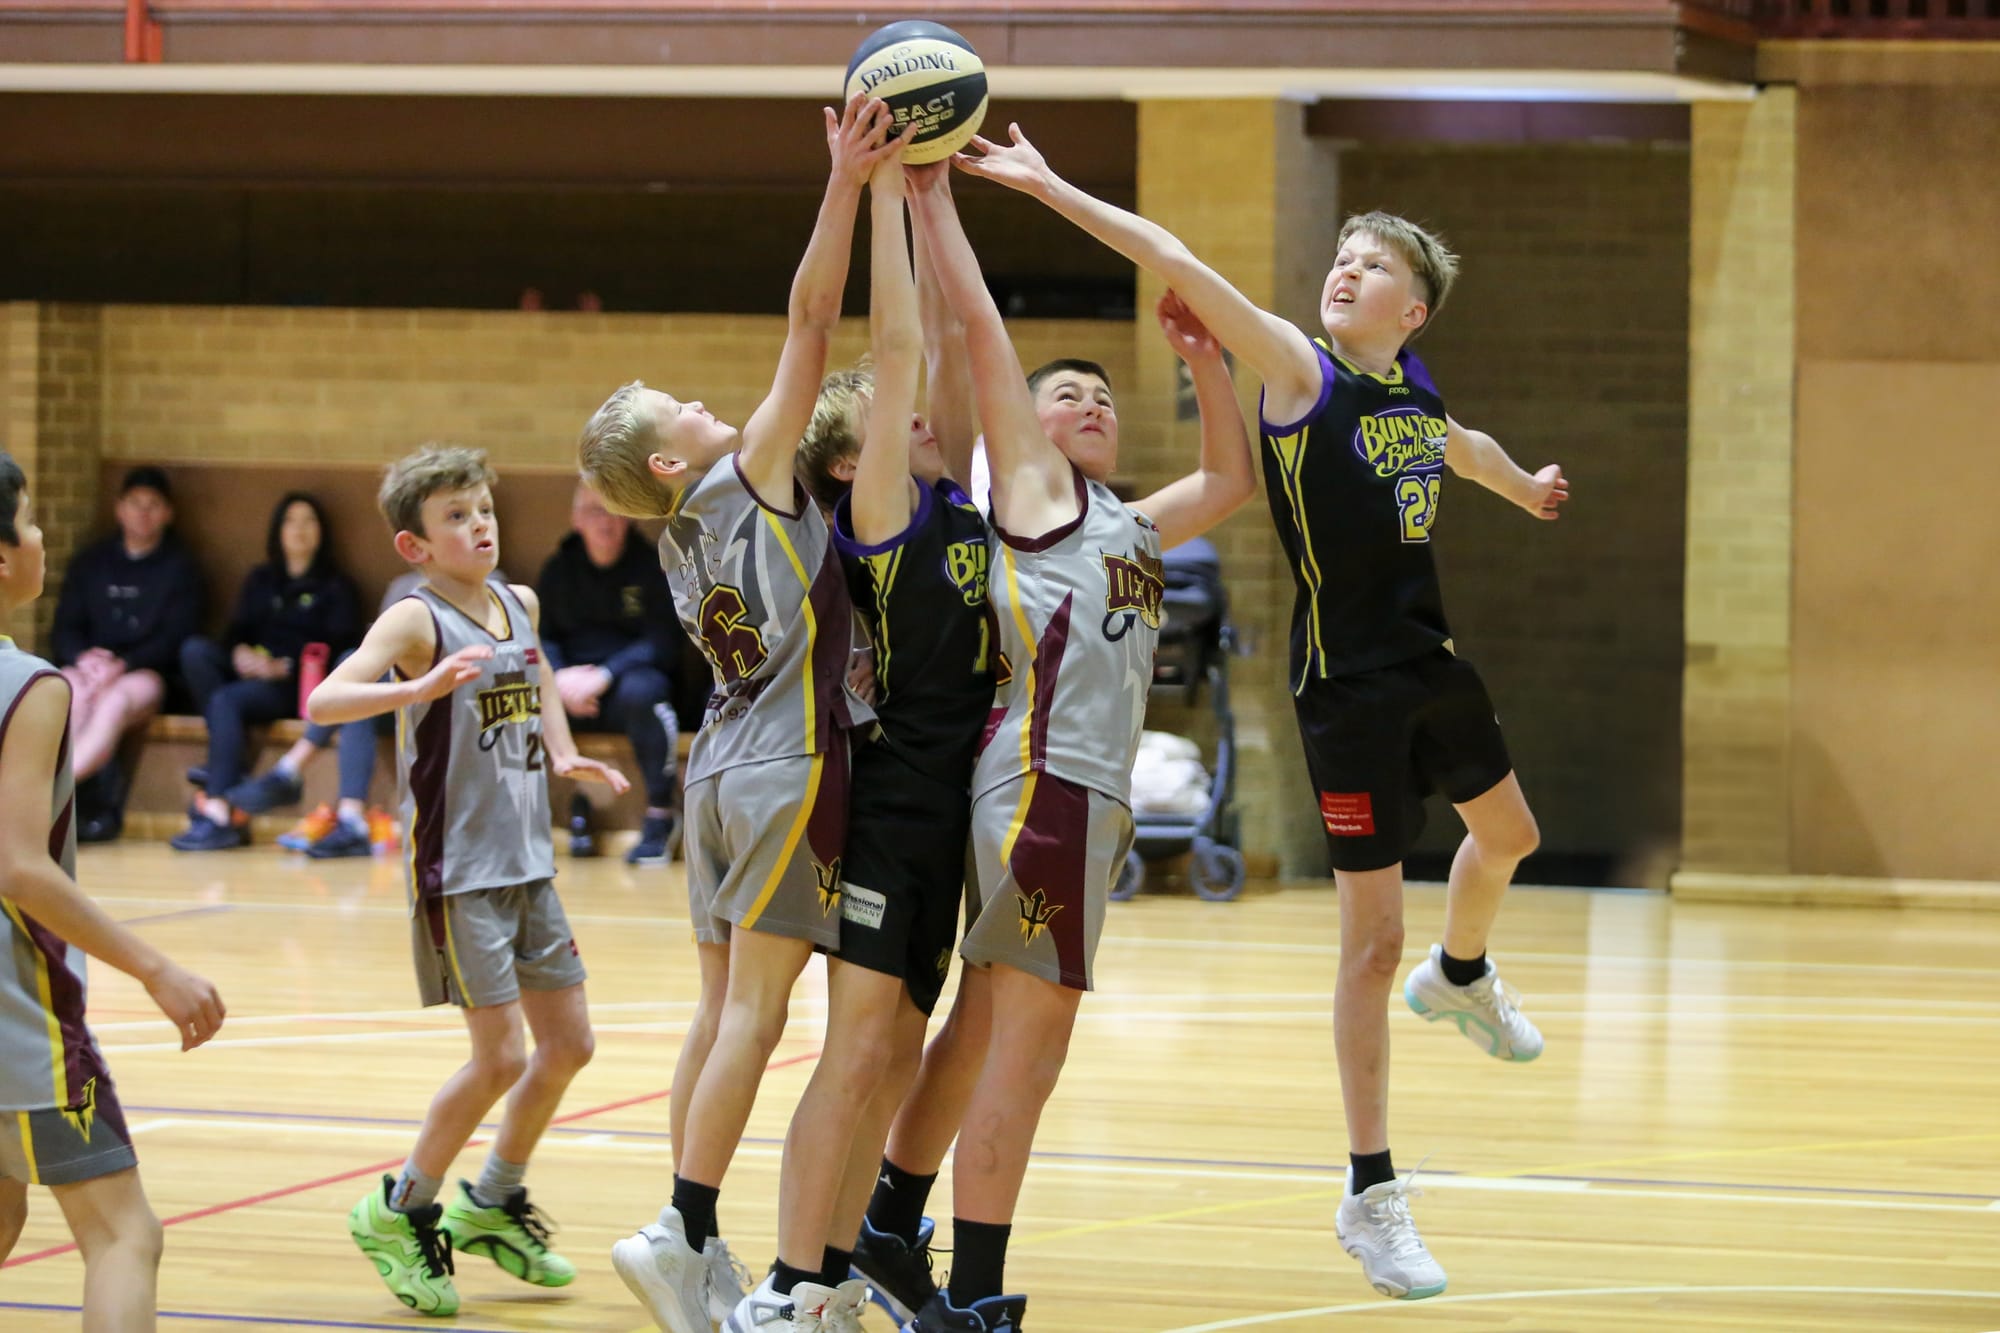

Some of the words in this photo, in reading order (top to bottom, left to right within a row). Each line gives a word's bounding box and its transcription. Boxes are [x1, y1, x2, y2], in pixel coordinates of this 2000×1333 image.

[860, 52, 955, 94] SPALDING
[894, 91, 955, 122] EACT
[846, 902, 881, 919] OMPANY
